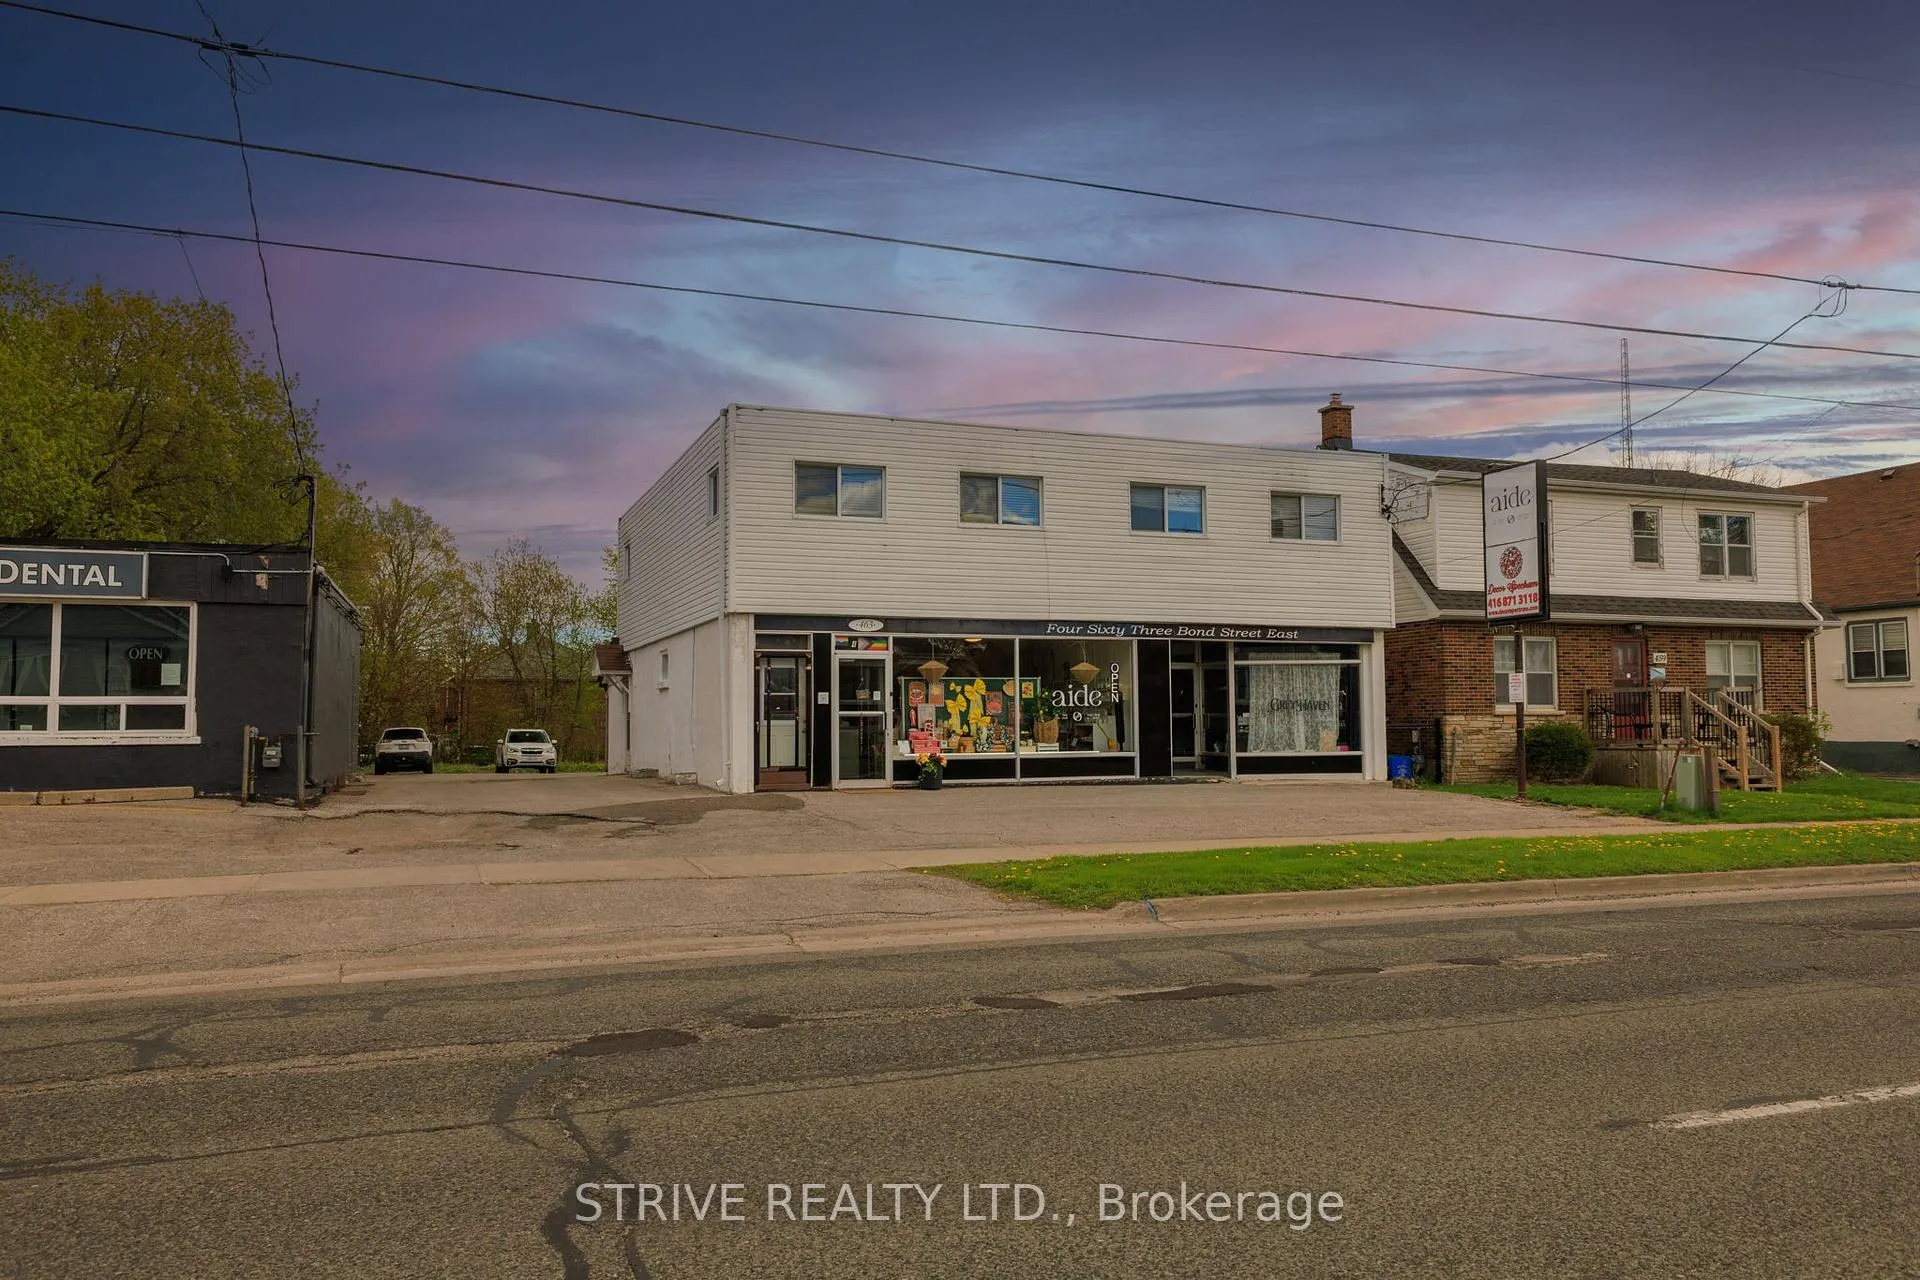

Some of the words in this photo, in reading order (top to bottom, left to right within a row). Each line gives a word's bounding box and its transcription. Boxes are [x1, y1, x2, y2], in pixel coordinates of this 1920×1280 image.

[1490, 485, 1531, 513] aide
[0, 559, 123, 587] DENTAL
[1488, 597, 1502, 608] 416
[1503, 595, 1517, 606] 871
[1518, 593, 1538, 604] 3118
[1046, 623, 1083, 634] Four
[1087, 623, 1126, 637] Sixty
[1131, 624, 1173, 636] Three
[1176, 626, 1216, 637] Bond
[1220, 627, 1262, 638] Street
[1267, 628, 1299, 639] East
[127, 647, 163, 661] OPEN
[1110, 663, 1120, 703] OPEN
[1052, 684, 1102, 707] aide
